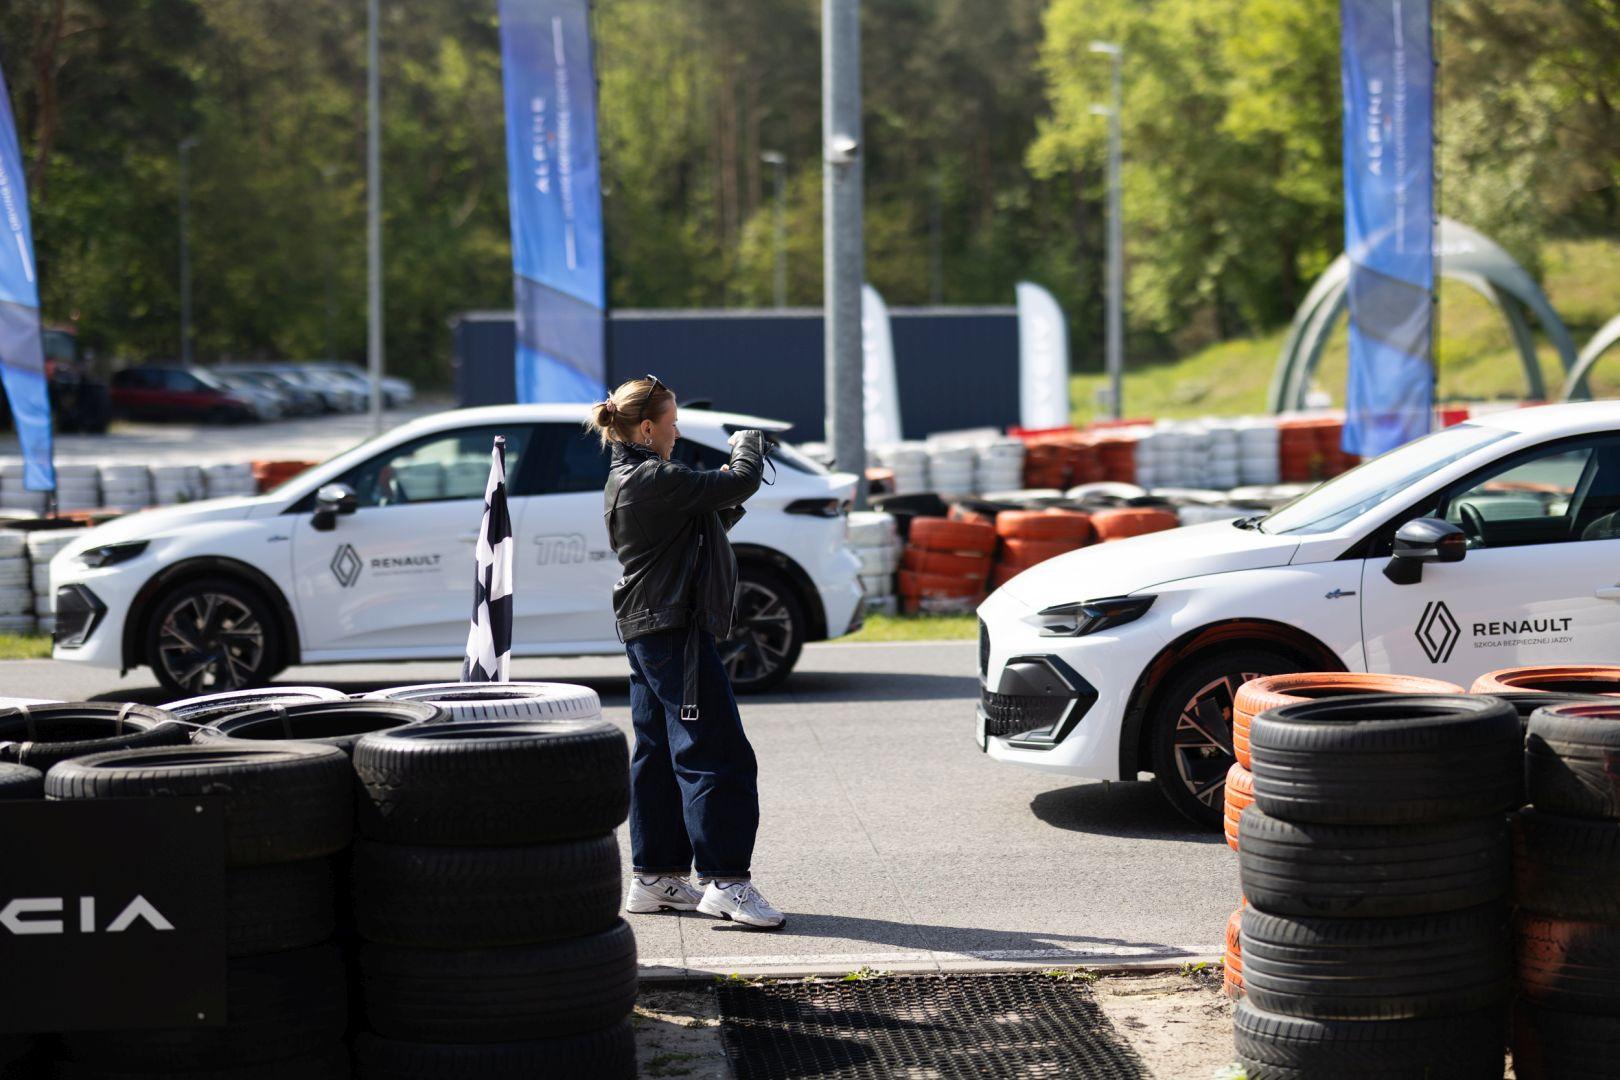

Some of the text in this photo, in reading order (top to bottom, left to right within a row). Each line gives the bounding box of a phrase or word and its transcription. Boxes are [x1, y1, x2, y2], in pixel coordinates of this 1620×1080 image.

[371, 554, 441, 569] RENAULT
[1473, 618, 1573, 637] RENAULT
[1551, 636, 1573, 644] JAZDY
